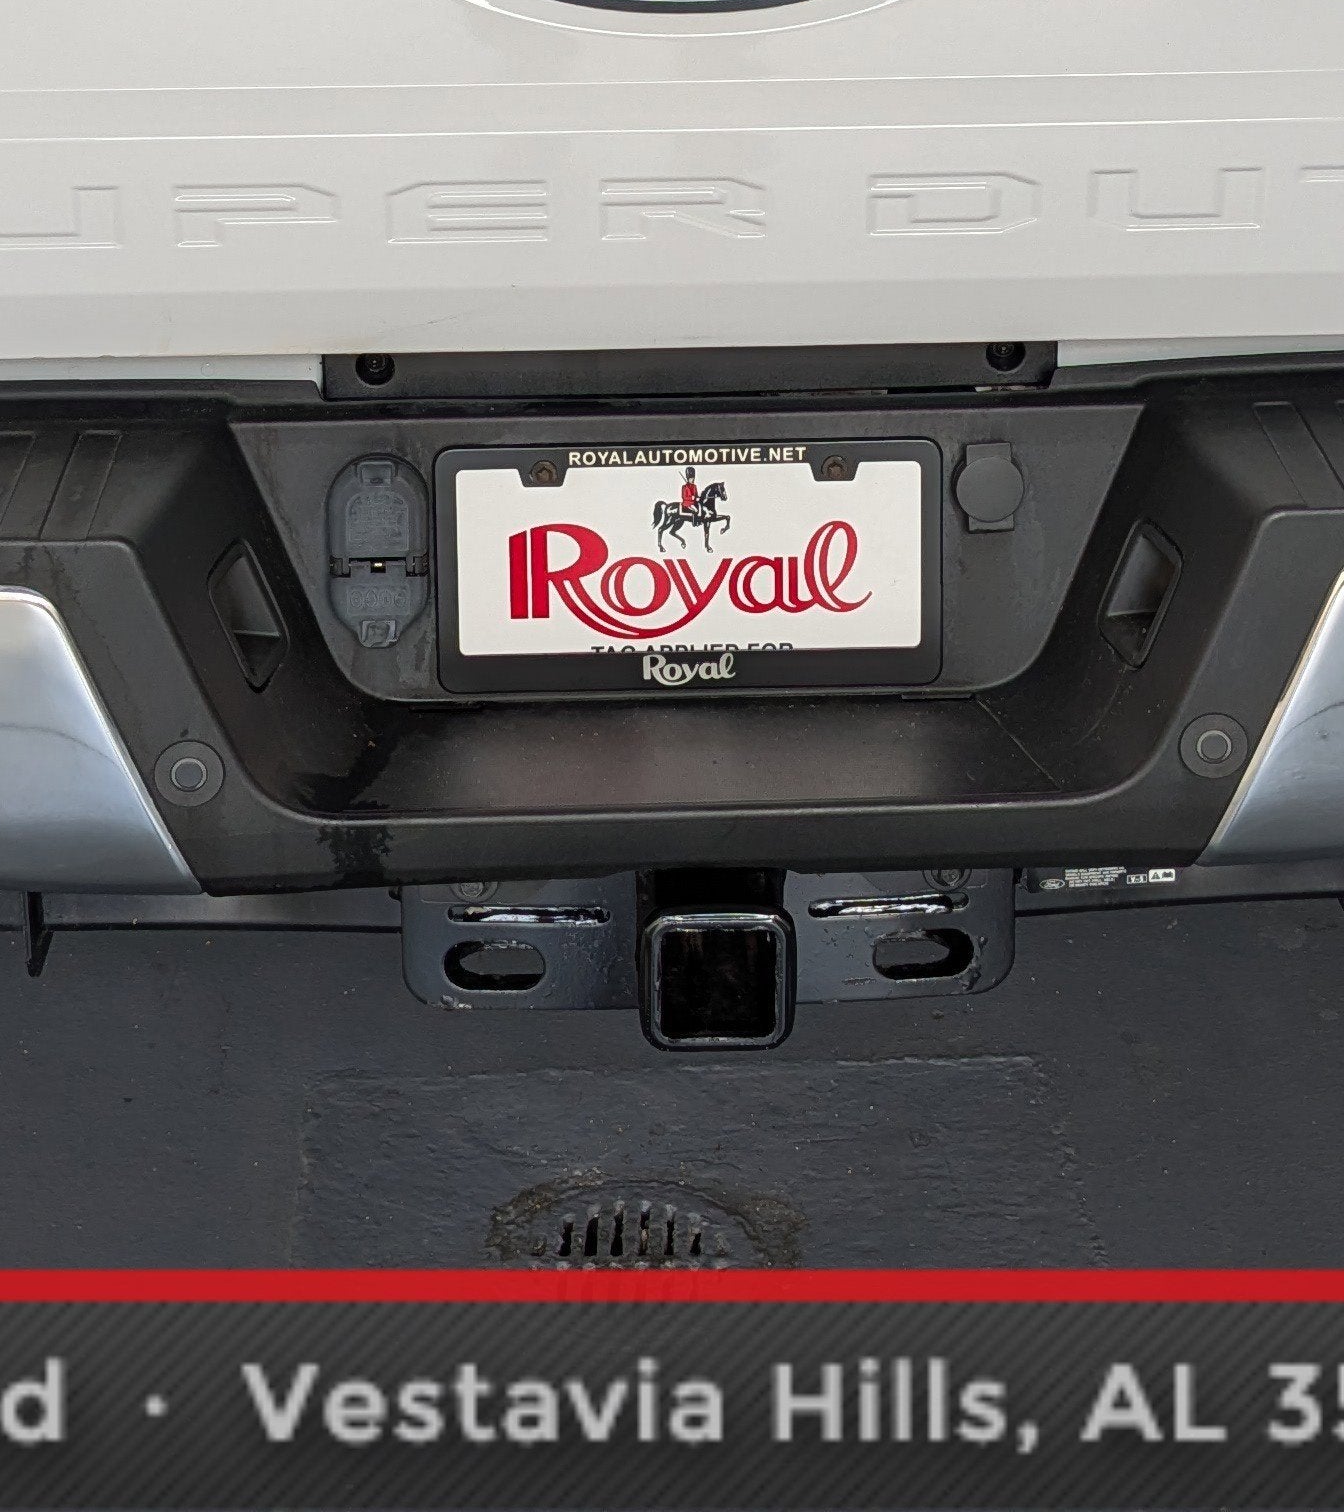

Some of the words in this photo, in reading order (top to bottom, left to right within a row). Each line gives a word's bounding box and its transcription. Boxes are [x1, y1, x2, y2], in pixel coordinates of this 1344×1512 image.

[567, 446, 807, 466] ROYALAUTOMOTIVE.NET
[508, 520, 873, 640] Royal
[642, 652, 737, 686] Royal
